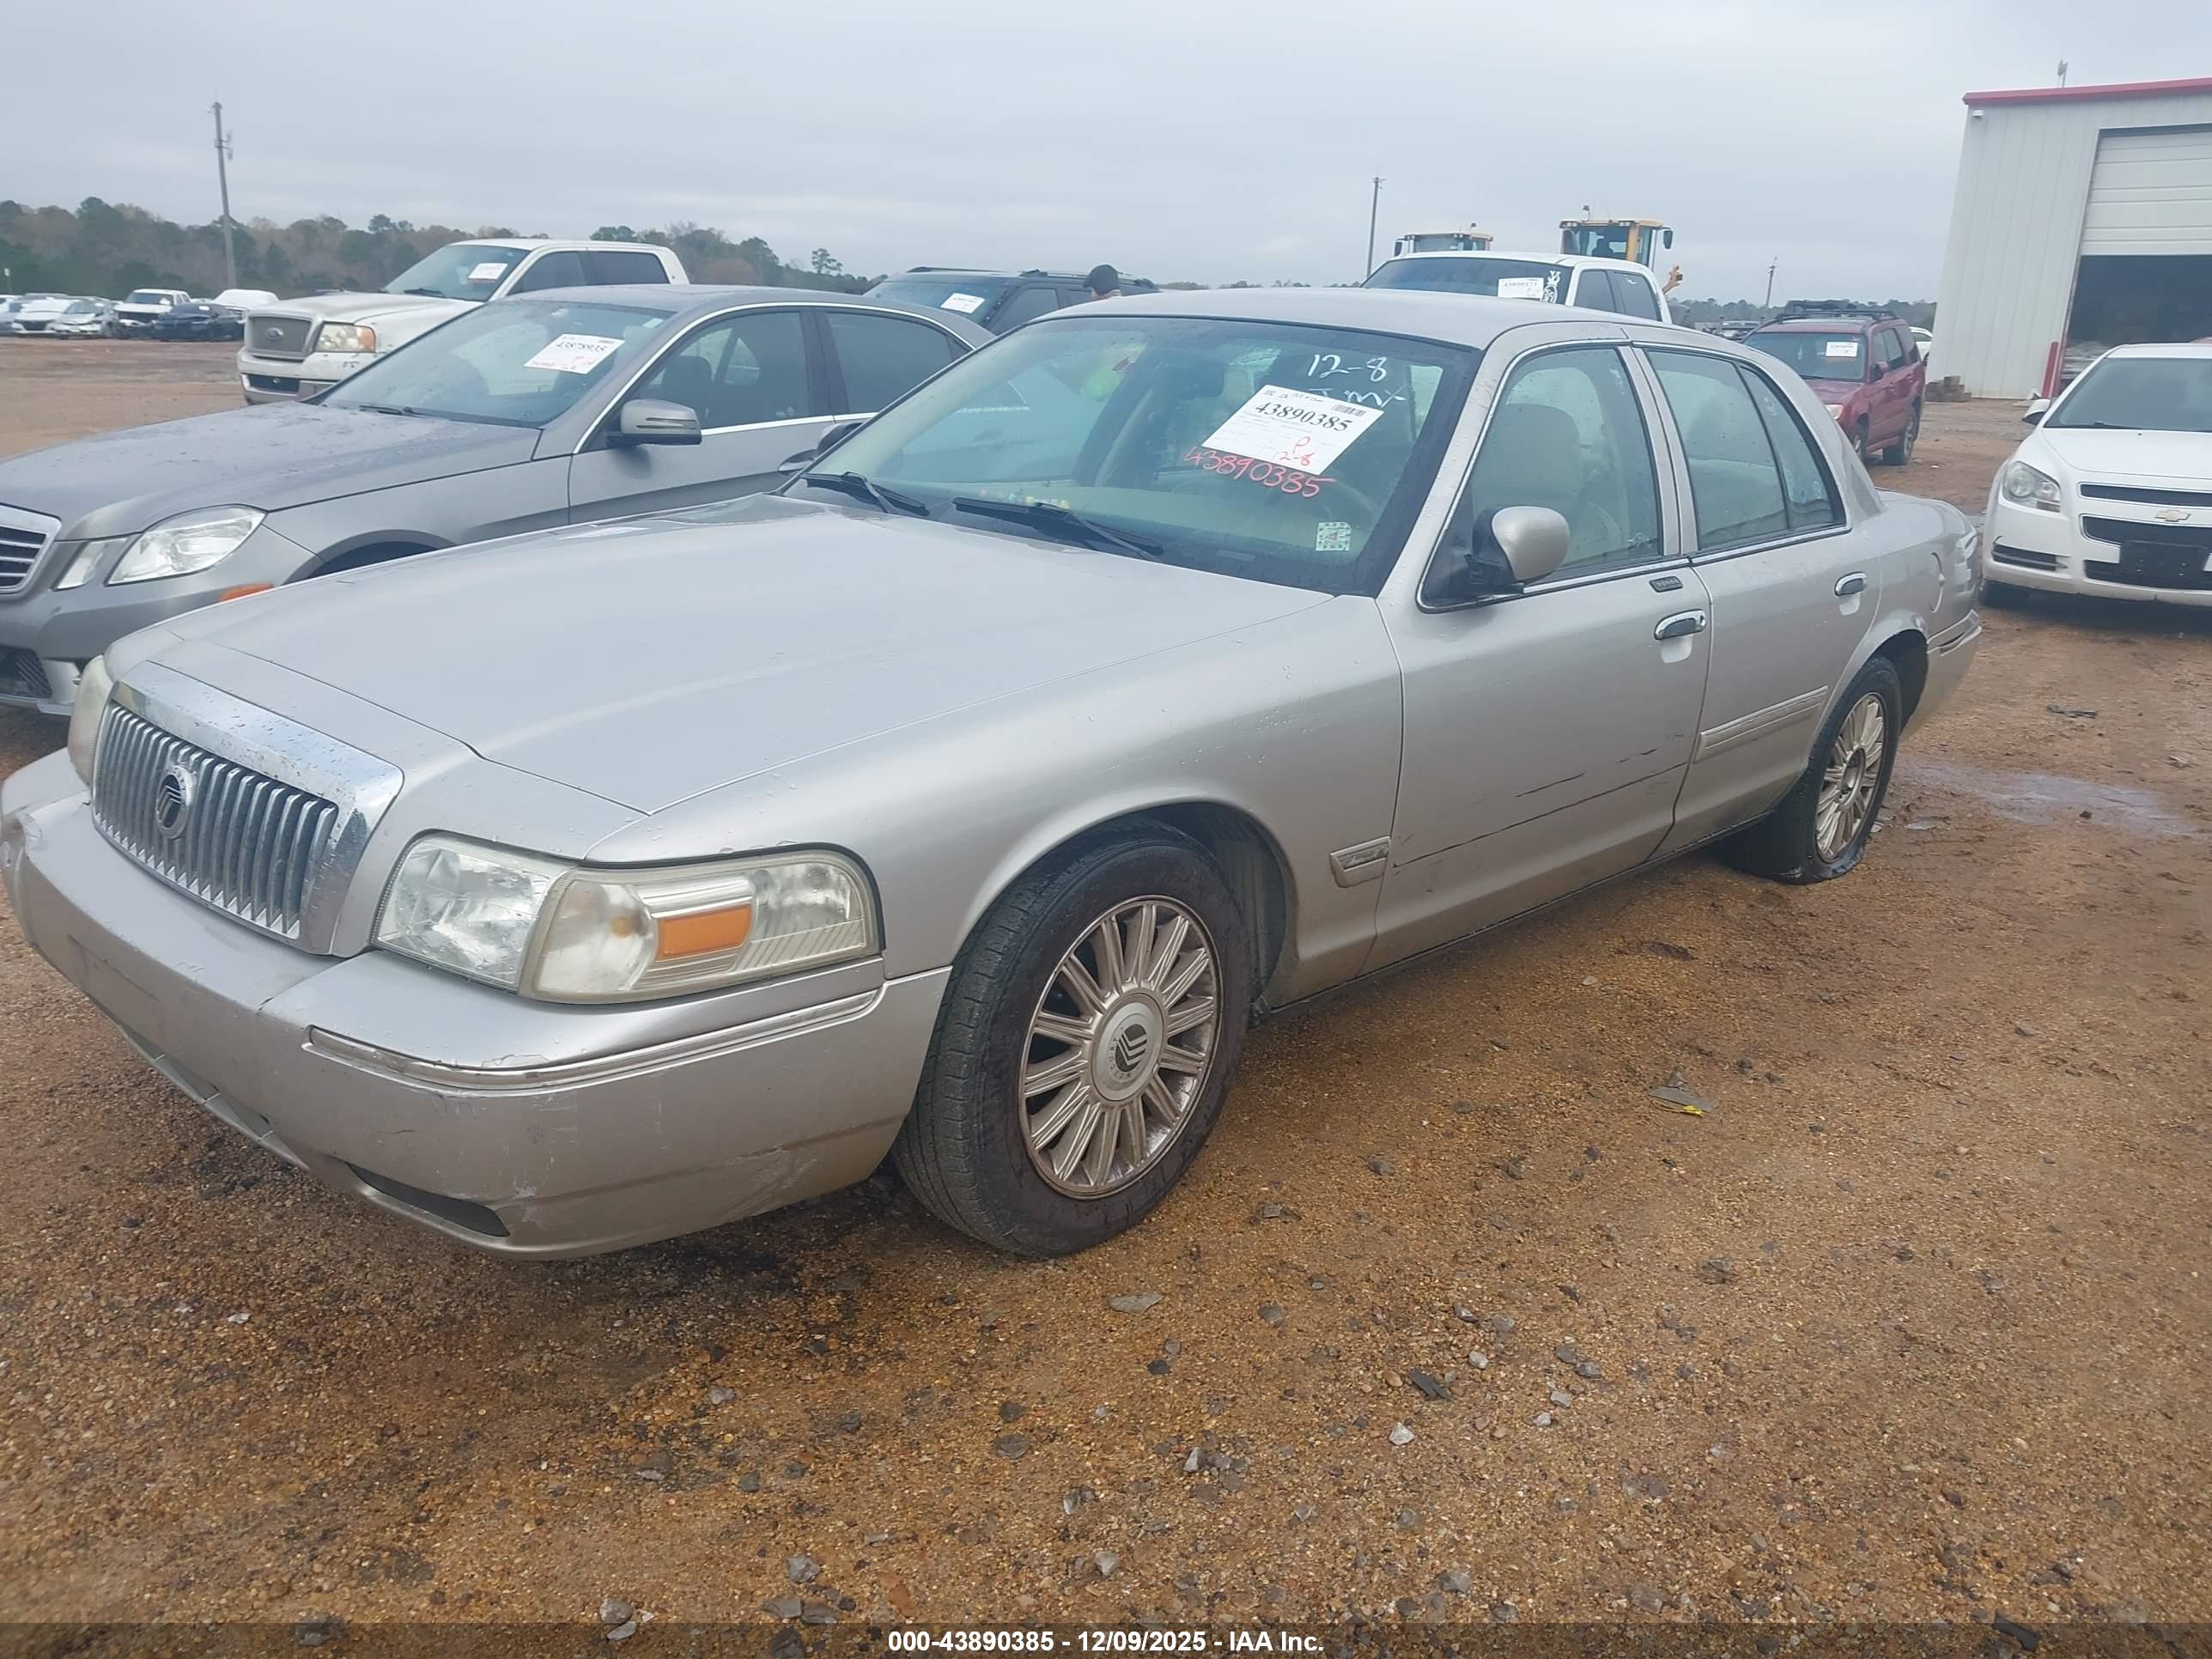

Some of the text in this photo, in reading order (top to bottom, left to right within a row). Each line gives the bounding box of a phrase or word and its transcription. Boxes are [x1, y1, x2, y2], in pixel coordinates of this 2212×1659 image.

[1307, 354, 1388, 383] 12-8
[1255, 402, 1353, 432] 43890385
[1182, 446, 1335, 498] 43890385
